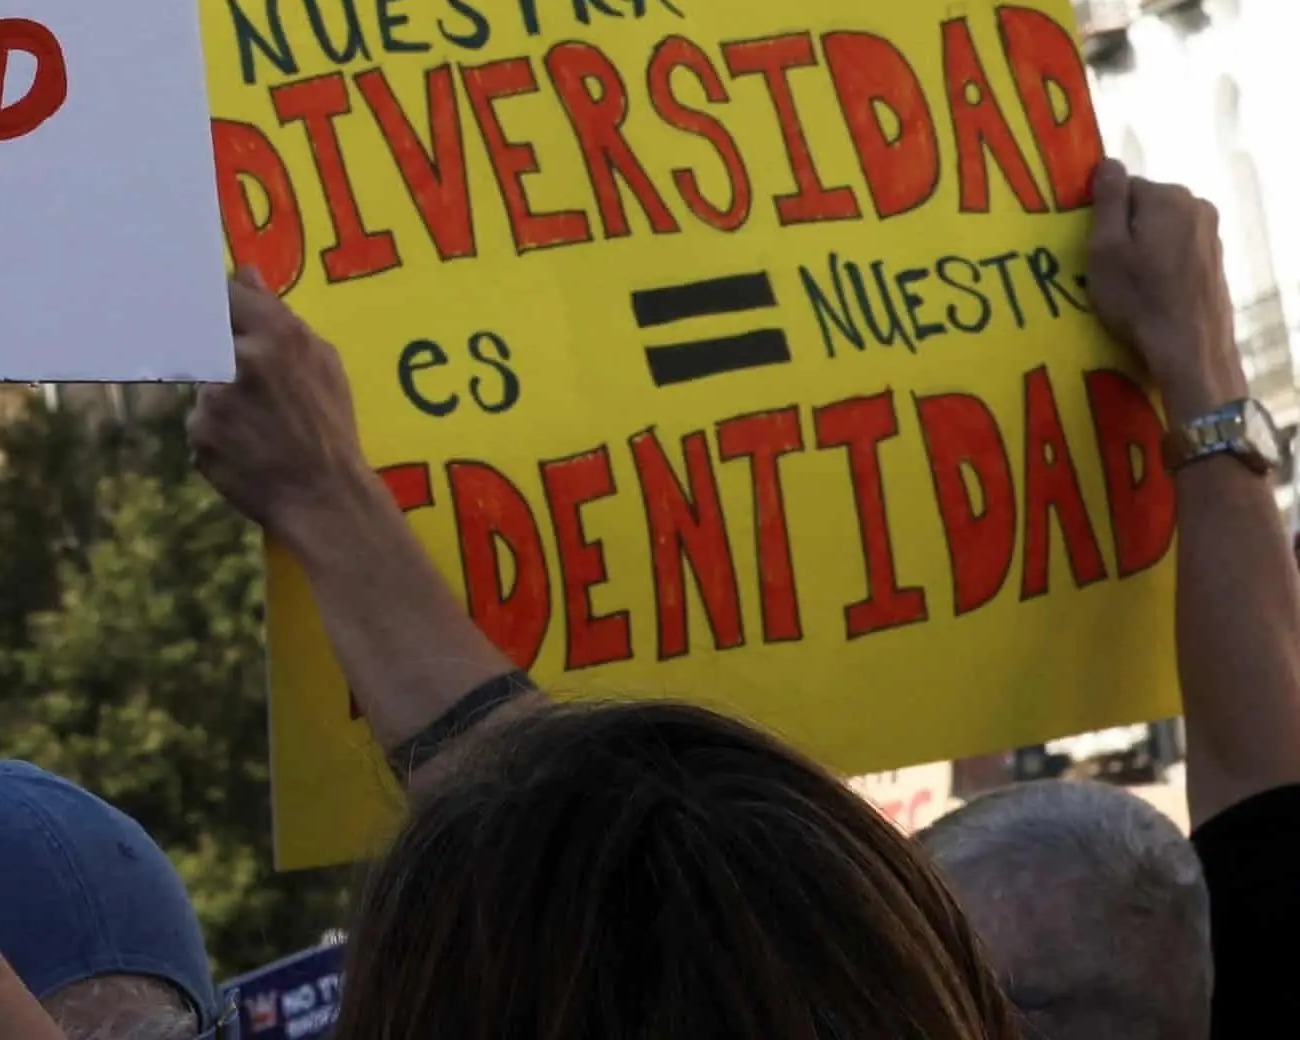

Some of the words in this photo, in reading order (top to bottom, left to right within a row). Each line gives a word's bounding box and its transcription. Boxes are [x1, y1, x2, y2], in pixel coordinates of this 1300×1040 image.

[210, 5, 1106, 298] DIVERSIDAD
[397, 331, 521, 418] es
[798, 246, 1092, 358] NUESTR
[350, 363, 1178, 720] DENTIDAD
